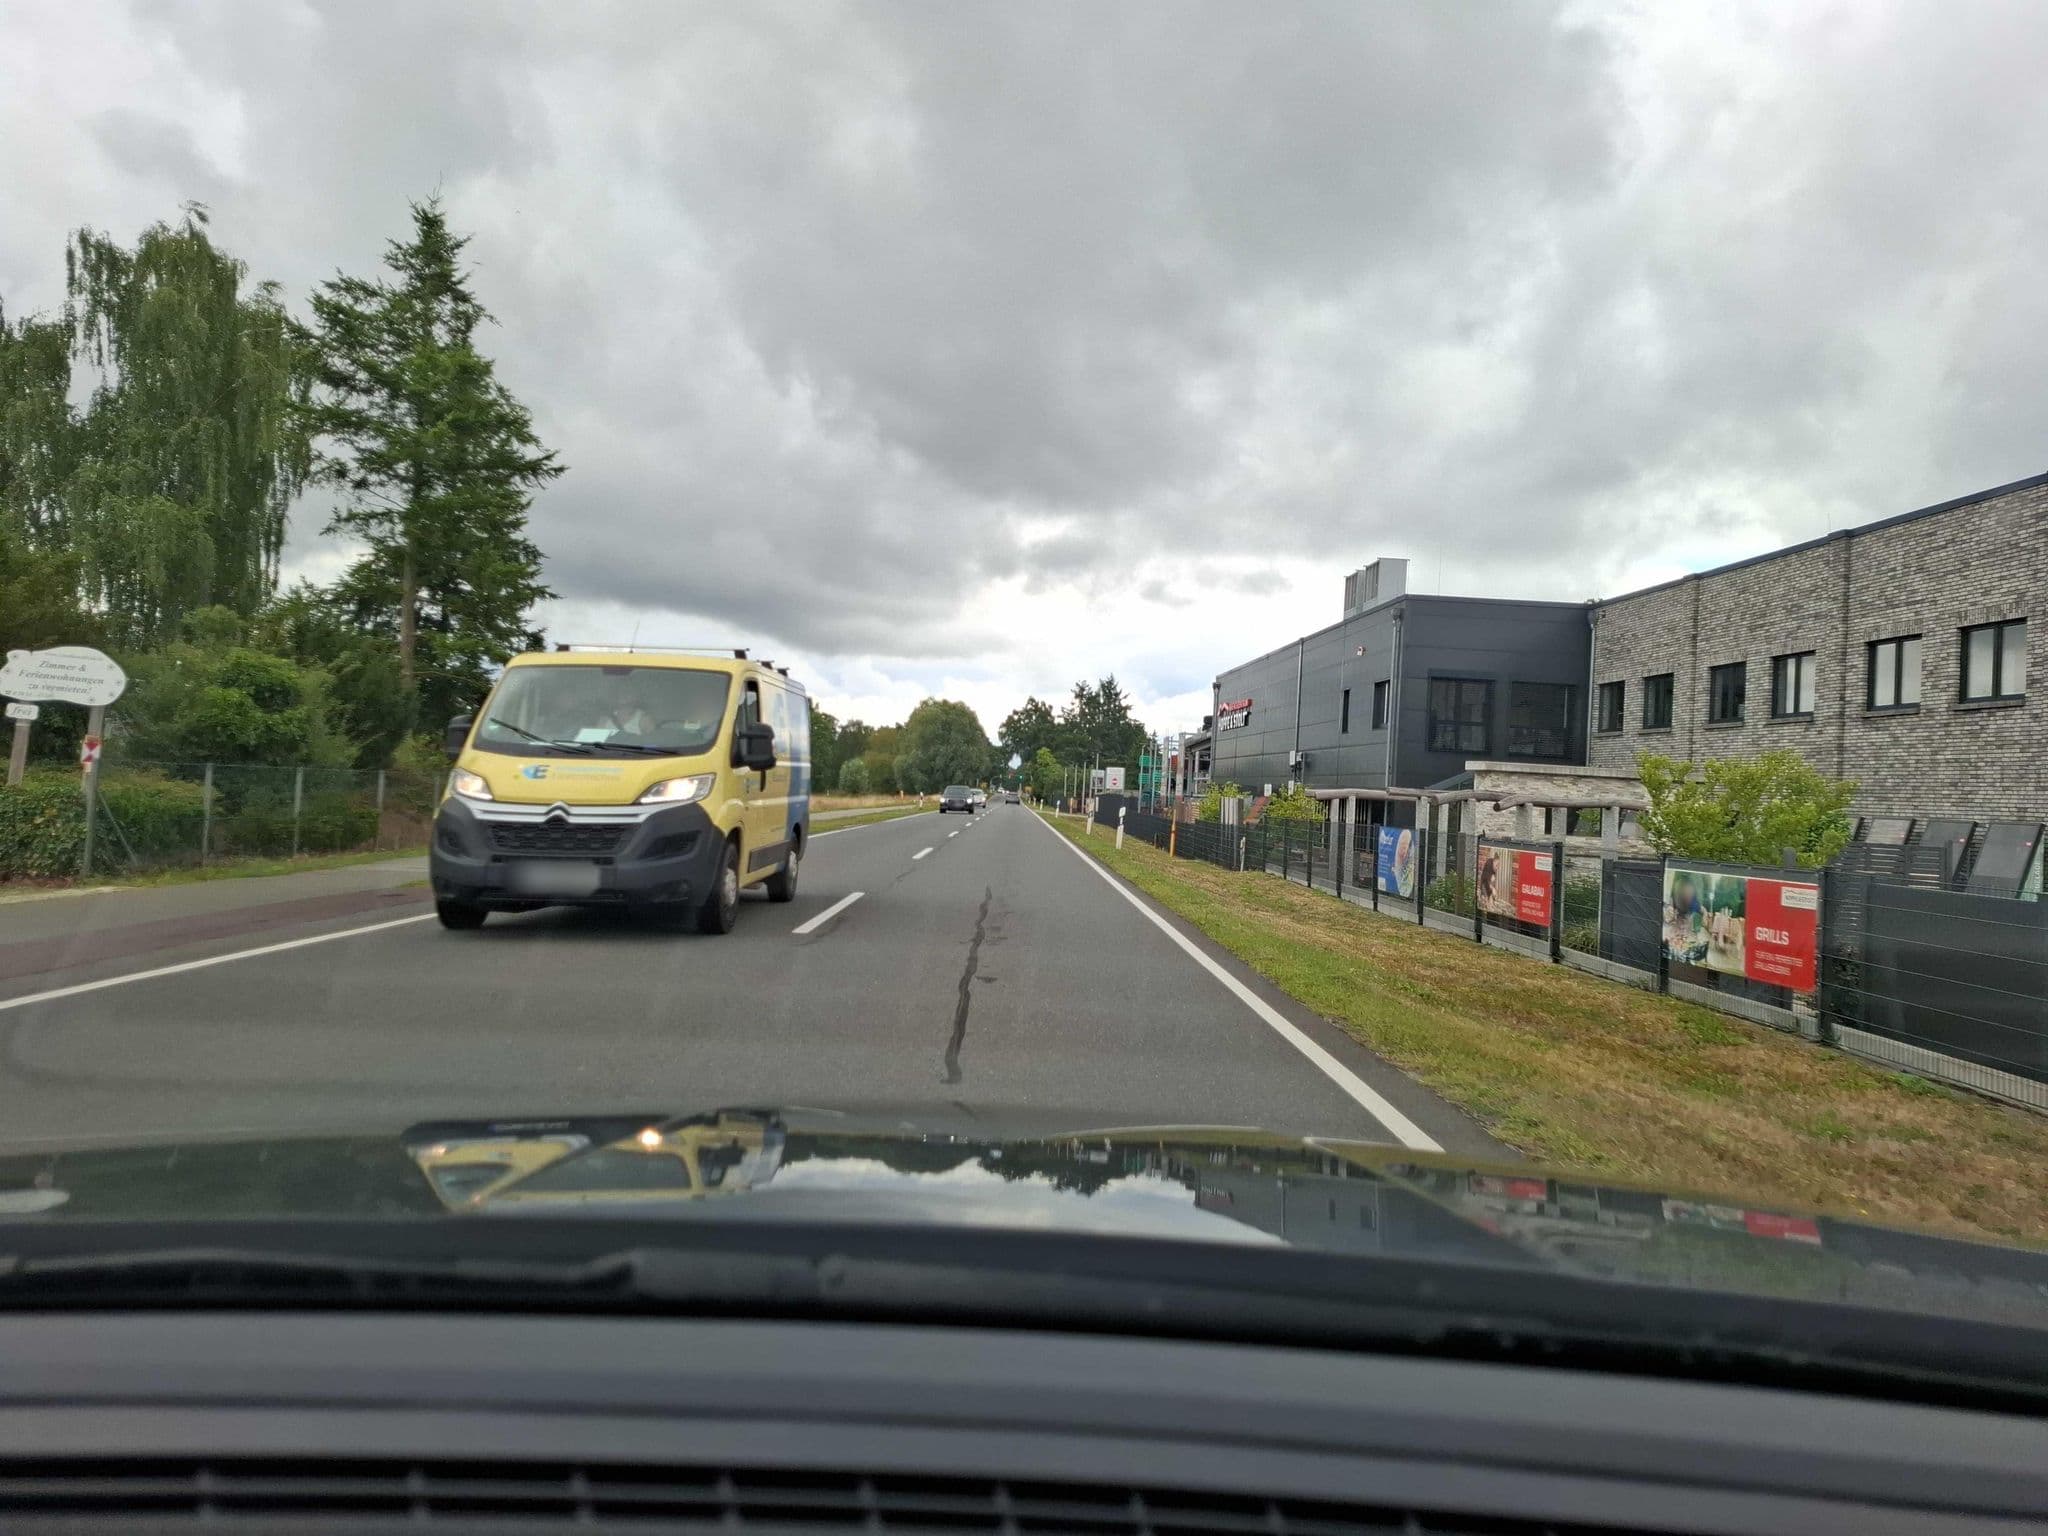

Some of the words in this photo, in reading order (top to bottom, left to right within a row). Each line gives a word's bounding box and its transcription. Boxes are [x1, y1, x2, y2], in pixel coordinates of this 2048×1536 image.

[39, 660, 77, 671] Zimmer
[78, 664, 87, 672] &
[18, 669, 104, 685] Ferienwohnungen
[1755, 926, 1790, 946] GRILLS
